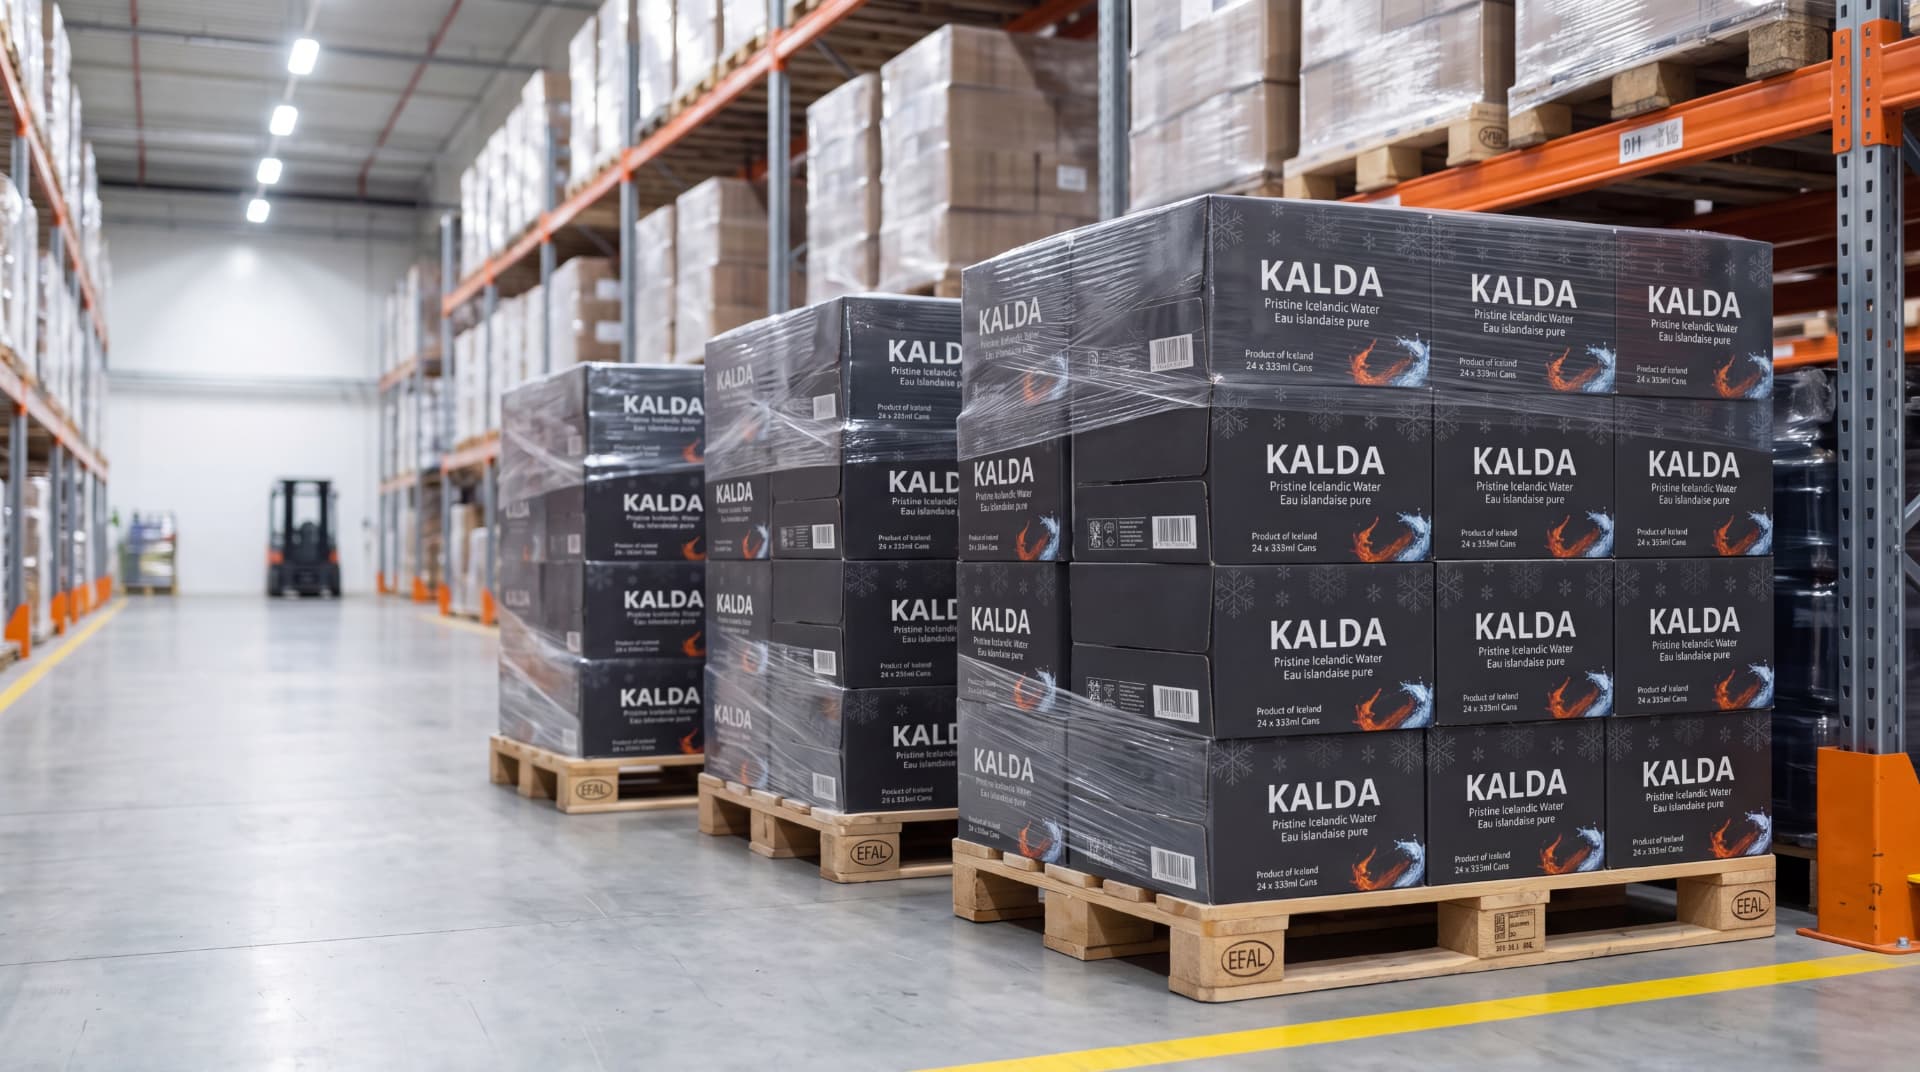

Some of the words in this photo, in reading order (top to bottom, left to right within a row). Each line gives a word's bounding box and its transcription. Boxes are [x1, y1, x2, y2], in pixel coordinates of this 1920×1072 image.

[1261, 259, 1383, 297] KALDA
[1472, 274, 1577, 308] KALDA
[1648, 285, 1741, 318] KALDA
[979, 296, 1042, 336] KALDA
[1264, 298, 1303, 310] Pristine
[1306, 300, 1348, 313] Icelandic
[1351, 303, 1380, 314] Water
[1275, 312, 1293, 323] Eau
[1296, 314, 1344, 326] islandaise
[1347, 319, 1370, 328] pure
[889, 339, 962, 364] KALD
[1245, 349, 1275, 359] Product
[1276, 350, 1285, 359] of
[1246, 361, 1257, 370] 24
[717, 364, 753, 392] KALDA
[624, 395, 704, 415] KALDA
[1267, 444, 1385, 475] KALDA
[1474, 447, 1576, 476] KALDA
[1649, 450, 1740, 478] KALDA
[889, 470, 959, 493] KALD
[974, 457, 1034, 486] KALDA
[716, 481, 753, 503] KALDA
[1270, 481, 1307, 491] Pristine
[1309, 481, 1351, 492] Icelandic
[1353, 482, 1381, 492] Water
[623, 493, 704, 513] KALDA
[1280, 494, 1298, 505] Eau
[1300, 494, 1348, 505] islandaise
[1350, 497, 1371, 507] pure
[1252, 532, 1280, 540] Product
[1282, 532, 1290, 540] of
[1252, 544, 1262, 552] 24
[624, 589, 704, 609] KALDA
[716, 593, 753, 615] KALDA
[892, 599, 958, 621] KALD
[971, 606, 1031, 634] KALDA
[1476, 611, 1576, 640] KALDA
[1650, 606, 1740, 634] KALDA
[1271, 618, 1386, 650] KALDA
[1274, 656, 1310, 667] Pristine
[1312, 654, 1353, 666] Icelandic
[1355, 654, 1382, 663] Water
[1284, 670, 1302, 680] Eau
[1304, 668, 1350, 679] islandaise
[1352, 669, 1373, 680] pure
[621, 687, 701, 707] KALDA
[714, 704, 752, 730] KALDA
[1257, 707, 1285, 715] Product
[1286, 706, 1294, 714] of
[893, 722, 958, 747] KALD
[1257, 719, 1267, 728] 24
[974, 748, 1034, 783] KALDA
[1643, 756, 1734, 787] KALDA
[1269, 778, 1380, 813] KALDA
[1467, 769, 1567, 801] KALDA
[1272, 819, 1306, 830] Pristine
[1309, 815, 1348, 827] Icelandic
[1349, 814, 1377, 824] Water
[1281, 832, 1298, 842] Eau
[1301, 828, 1345, 840] islandaise
[1348, 828, 1368, 839] pure
[1256, 869, 1284, 879] Product
[1285, 868, 1292, 877] of
[1257, 882, 1266, 891] 24
